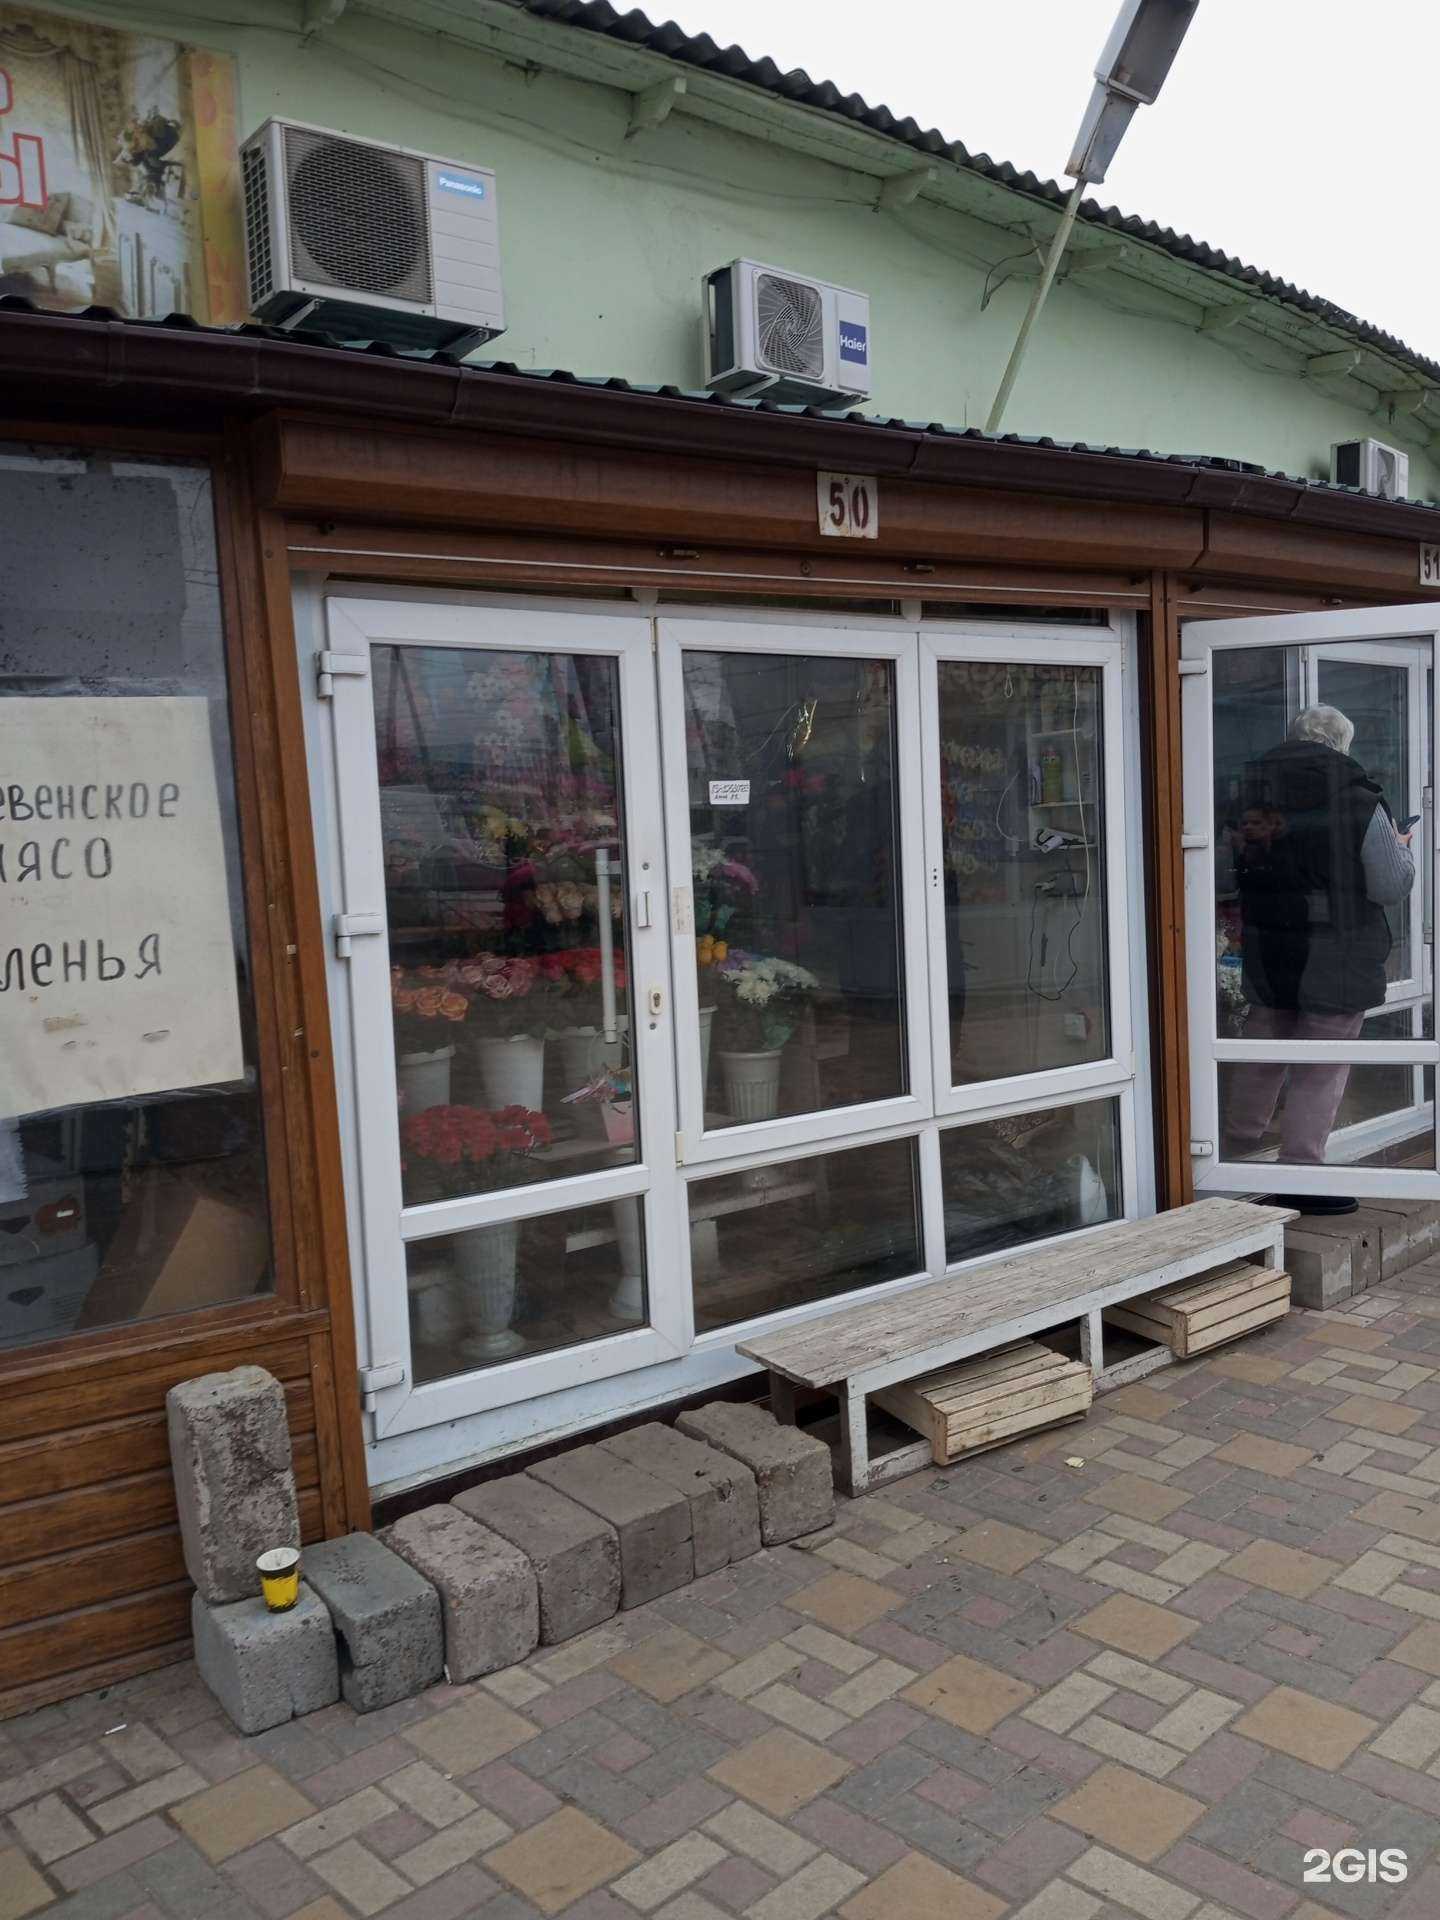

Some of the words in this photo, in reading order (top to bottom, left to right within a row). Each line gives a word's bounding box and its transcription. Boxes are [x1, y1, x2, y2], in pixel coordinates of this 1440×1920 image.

[439, 176, 483, 195] Panasonic
[840, 335, 866, 352] Haier
[830, 482, 869, 529] 50
[1424, 550, 1440, 580] 51
[0, 837, 112, 883] ясо
